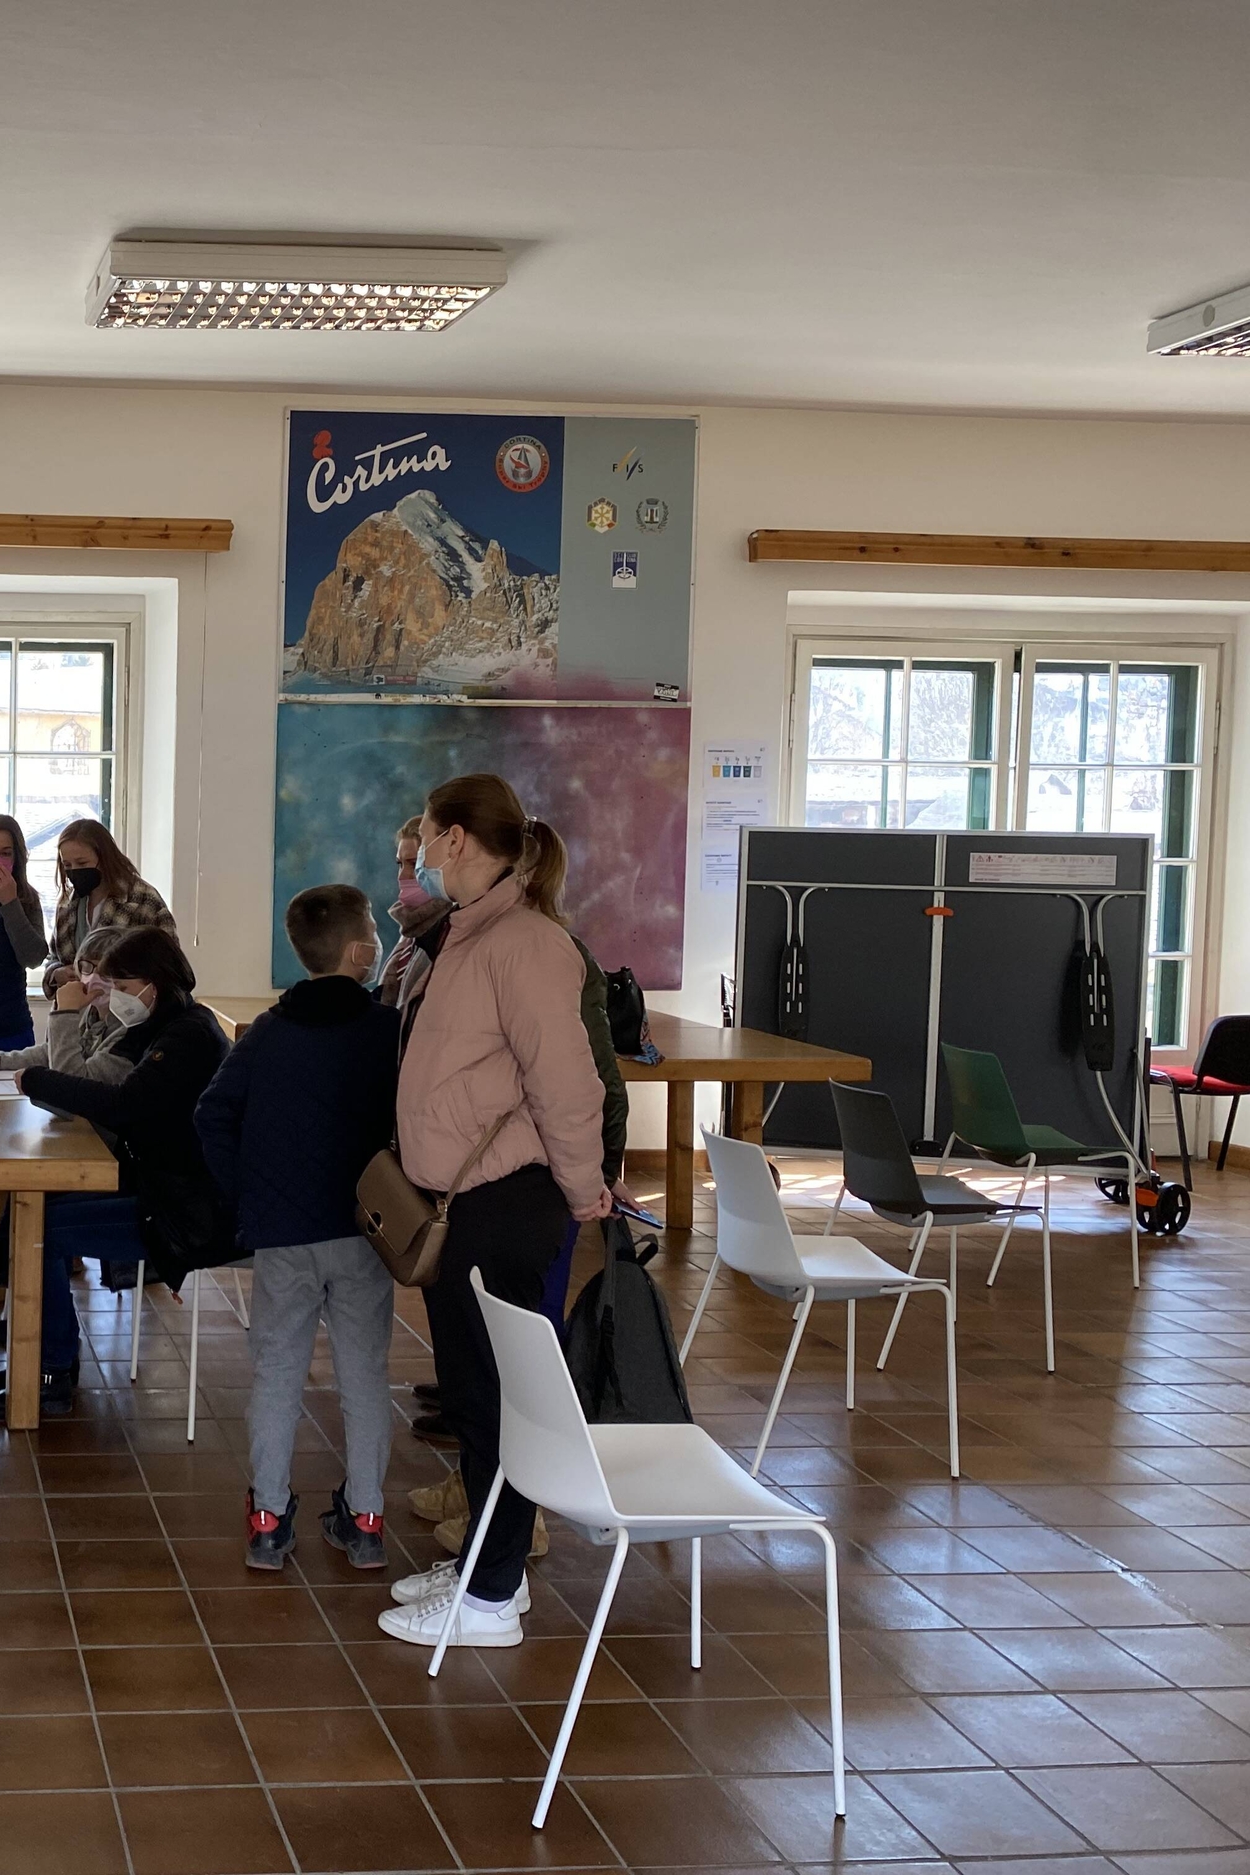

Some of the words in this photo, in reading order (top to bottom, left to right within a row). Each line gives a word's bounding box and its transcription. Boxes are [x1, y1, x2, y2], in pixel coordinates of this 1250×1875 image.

[504, 436, 542, 451] CORTINA
[307, 432, 452, 514] Cortina
[612, 463, 644, 473] FIS
